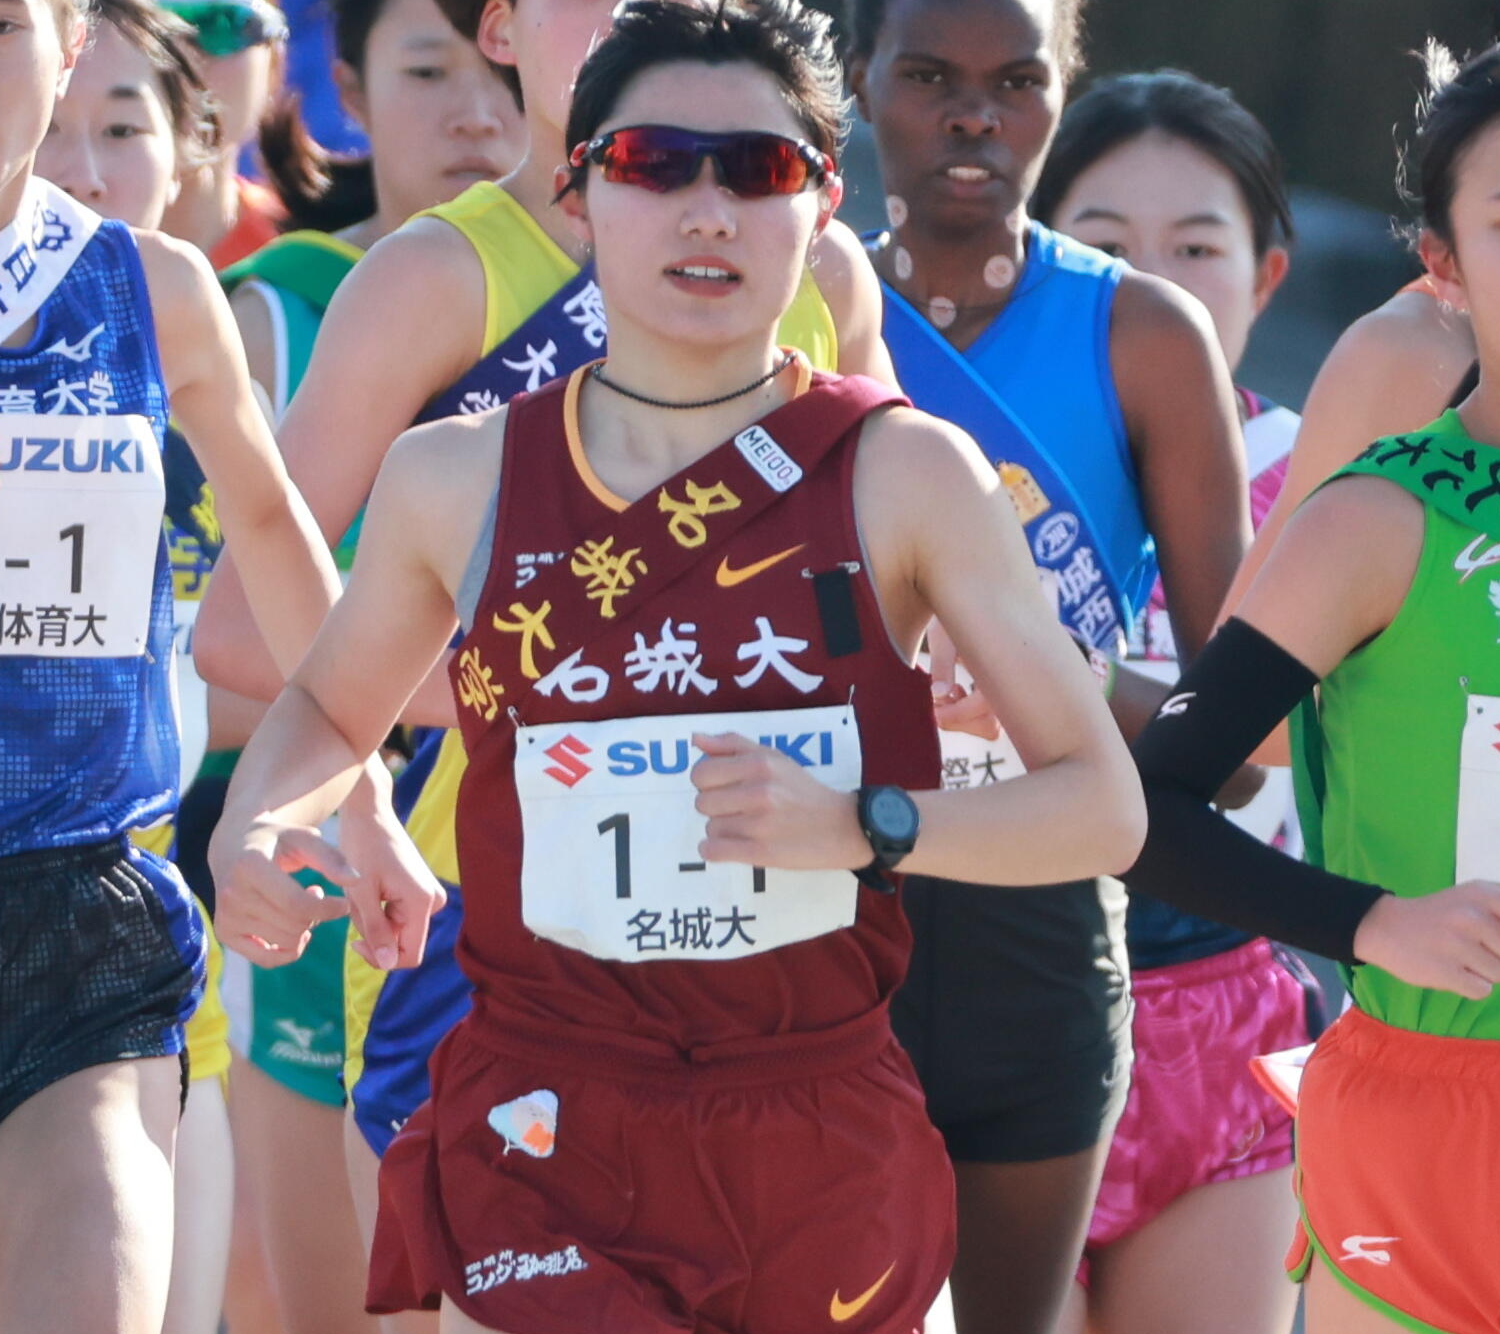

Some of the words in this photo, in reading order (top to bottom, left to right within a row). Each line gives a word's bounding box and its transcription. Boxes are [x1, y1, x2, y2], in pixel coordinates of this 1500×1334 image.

[453, 477, 744, 721] 名城大学
[625, 906, 757, 952] 名城大
